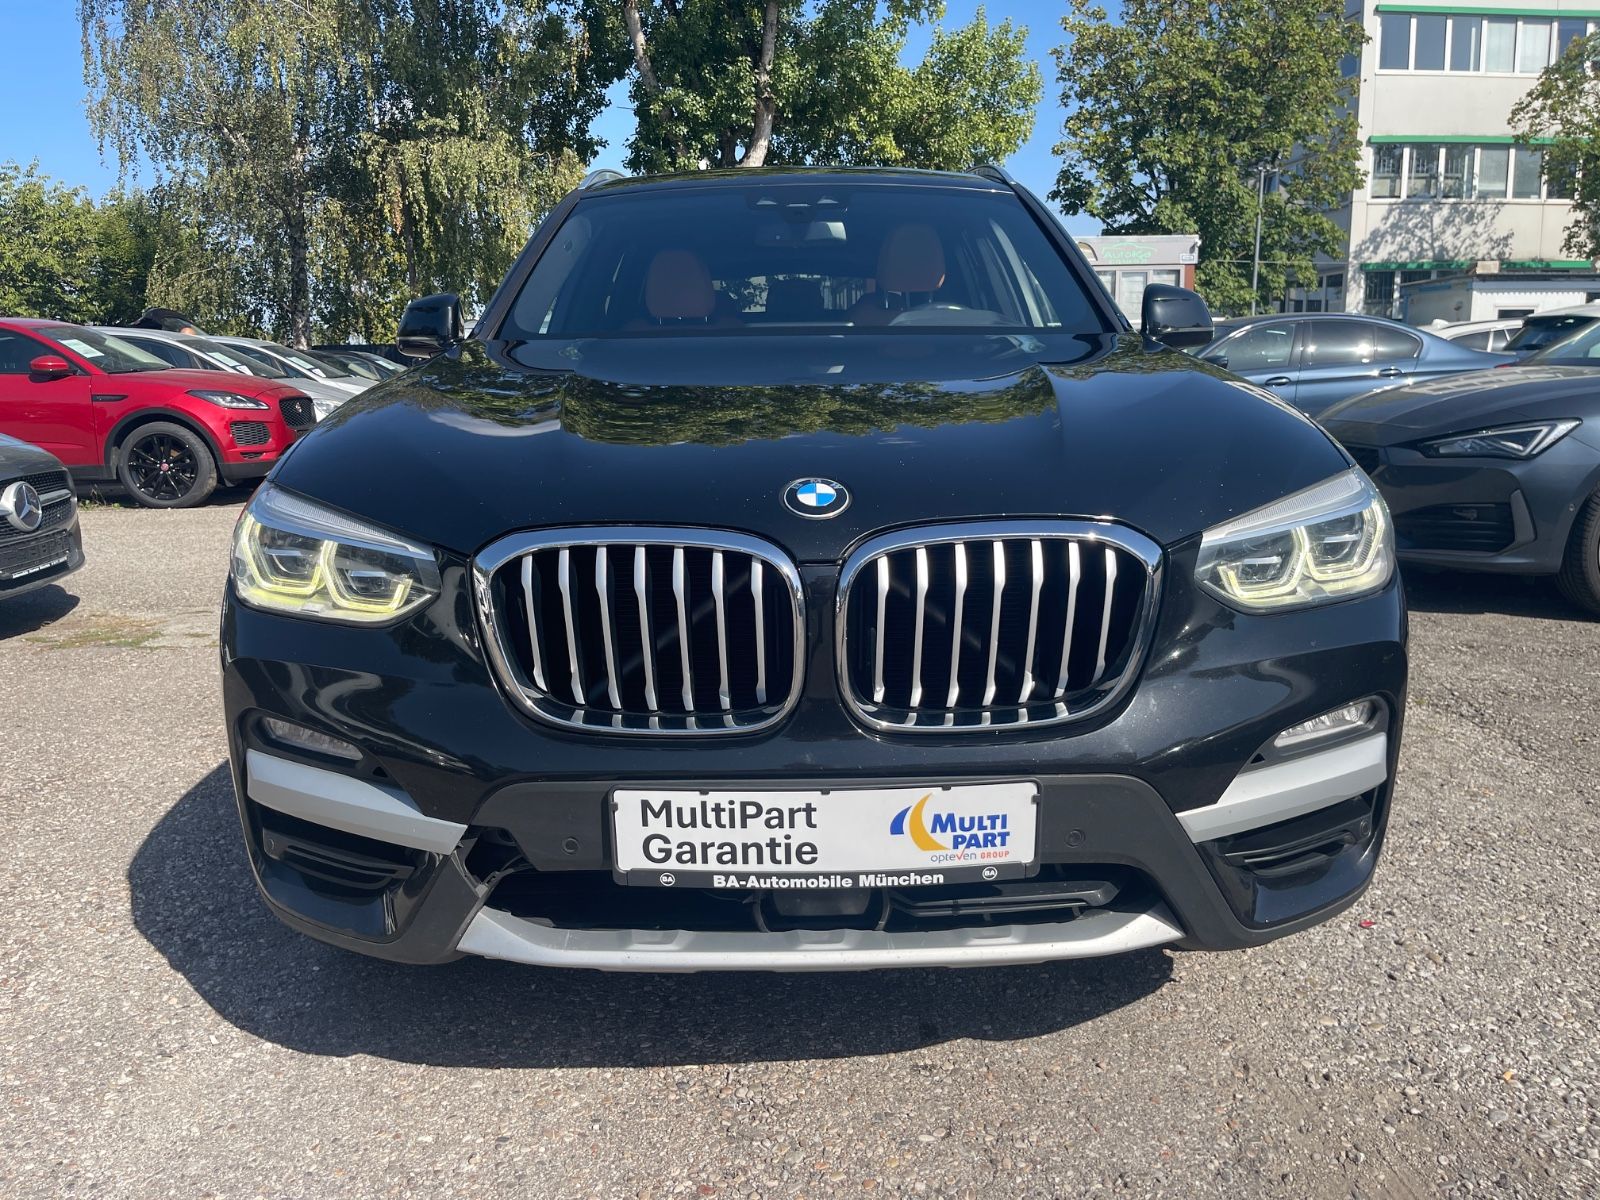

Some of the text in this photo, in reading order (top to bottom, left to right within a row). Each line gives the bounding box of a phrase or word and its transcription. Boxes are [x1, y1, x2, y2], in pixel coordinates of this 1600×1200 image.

[640, 799, 817, 829] MultiPart
[930, 813, 1008, 833] MULTI
[642, 833, 818, 865] Garantie
[952, 831, 1011, 850] PART
[930, 849, 1010, 863] opteven GROUP
[713, 872, 945, 889] BA-Automobile München
